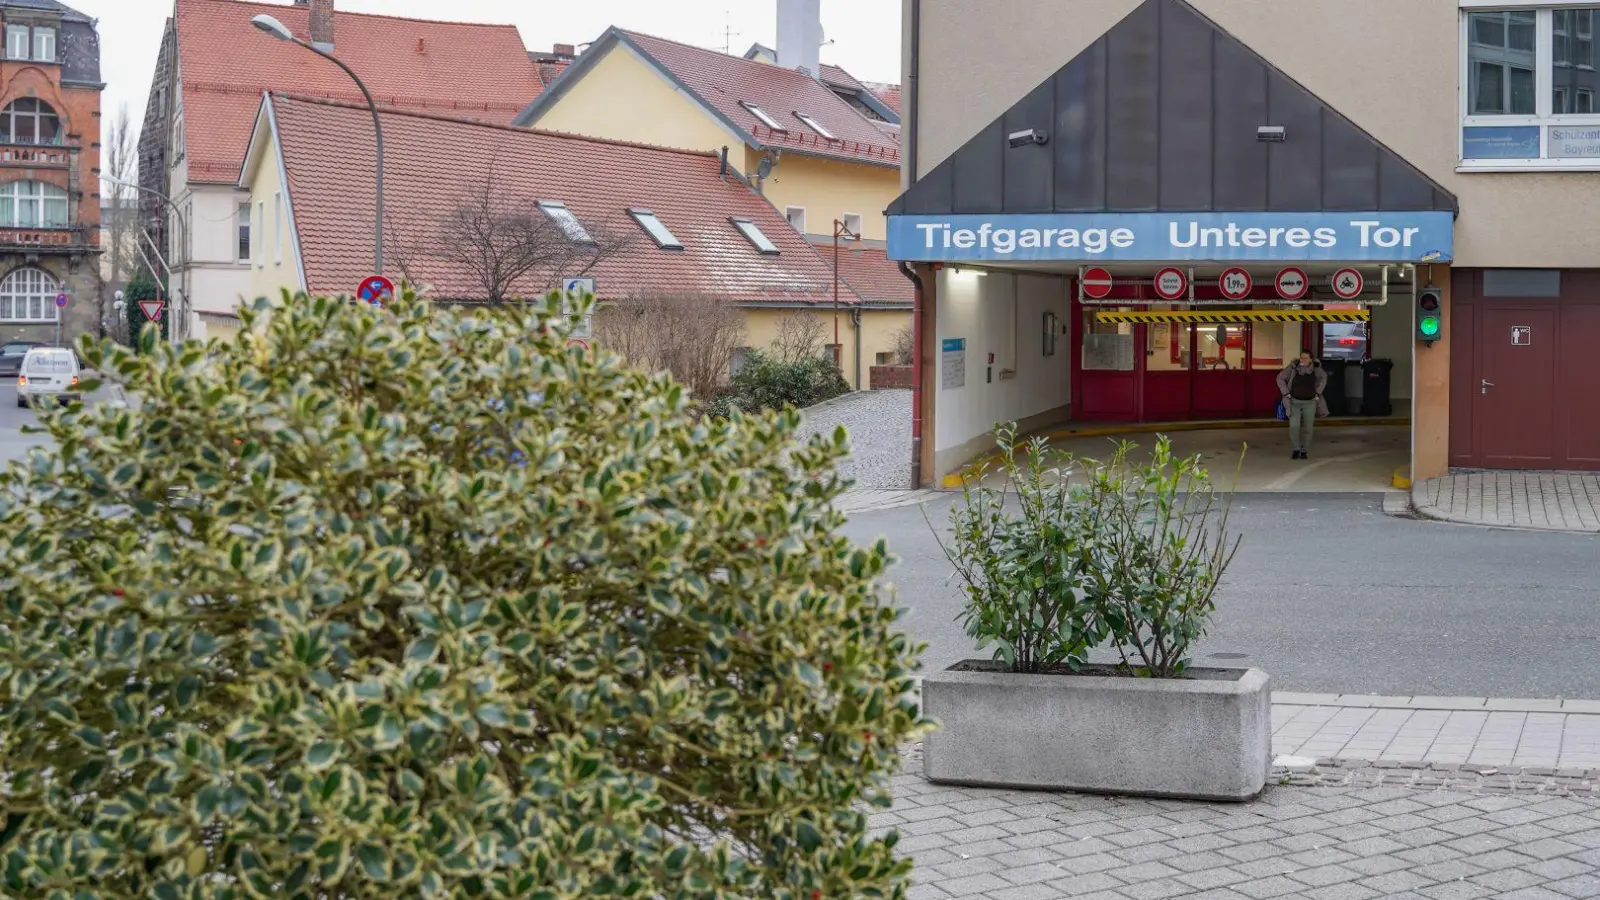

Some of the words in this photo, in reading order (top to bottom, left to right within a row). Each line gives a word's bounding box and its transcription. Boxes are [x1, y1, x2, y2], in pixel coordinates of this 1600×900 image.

[916, 223, 1135, 254] Tiefgarage
[1169, 221, 1337, 248] Unteres
[1350, 220, 1419, 247] Tor
